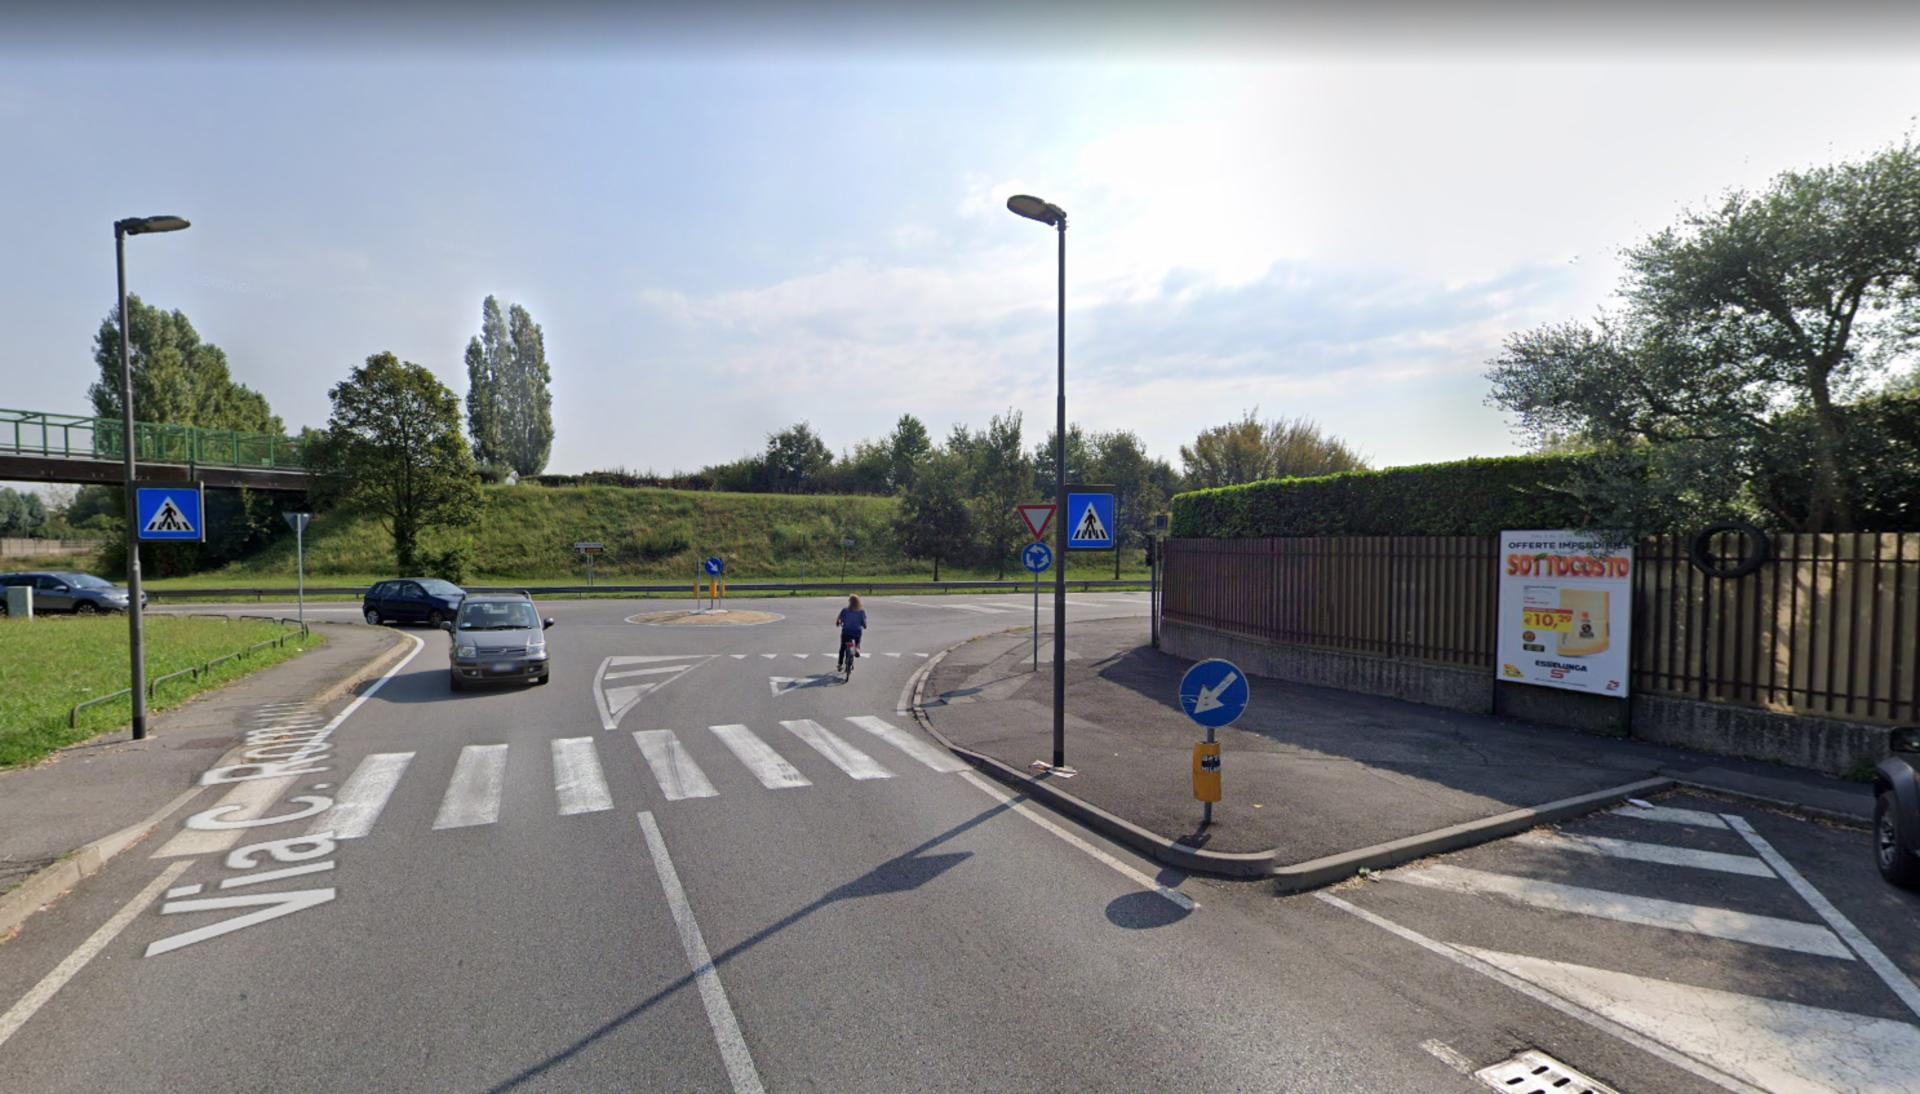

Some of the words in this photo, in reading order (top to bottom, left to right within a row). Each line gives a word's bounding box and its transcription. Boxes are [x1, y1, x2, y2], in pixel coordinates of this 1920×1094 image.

[1508, 541, 1555, 550] OFFERTE
[1507, 554, 1630, 577] SOTTOCOSTO
[1535, 660, 1588, 673] ESSELUNGA
[187, 783, 333, 829] C.
[144, 831, 335, 957] Via
